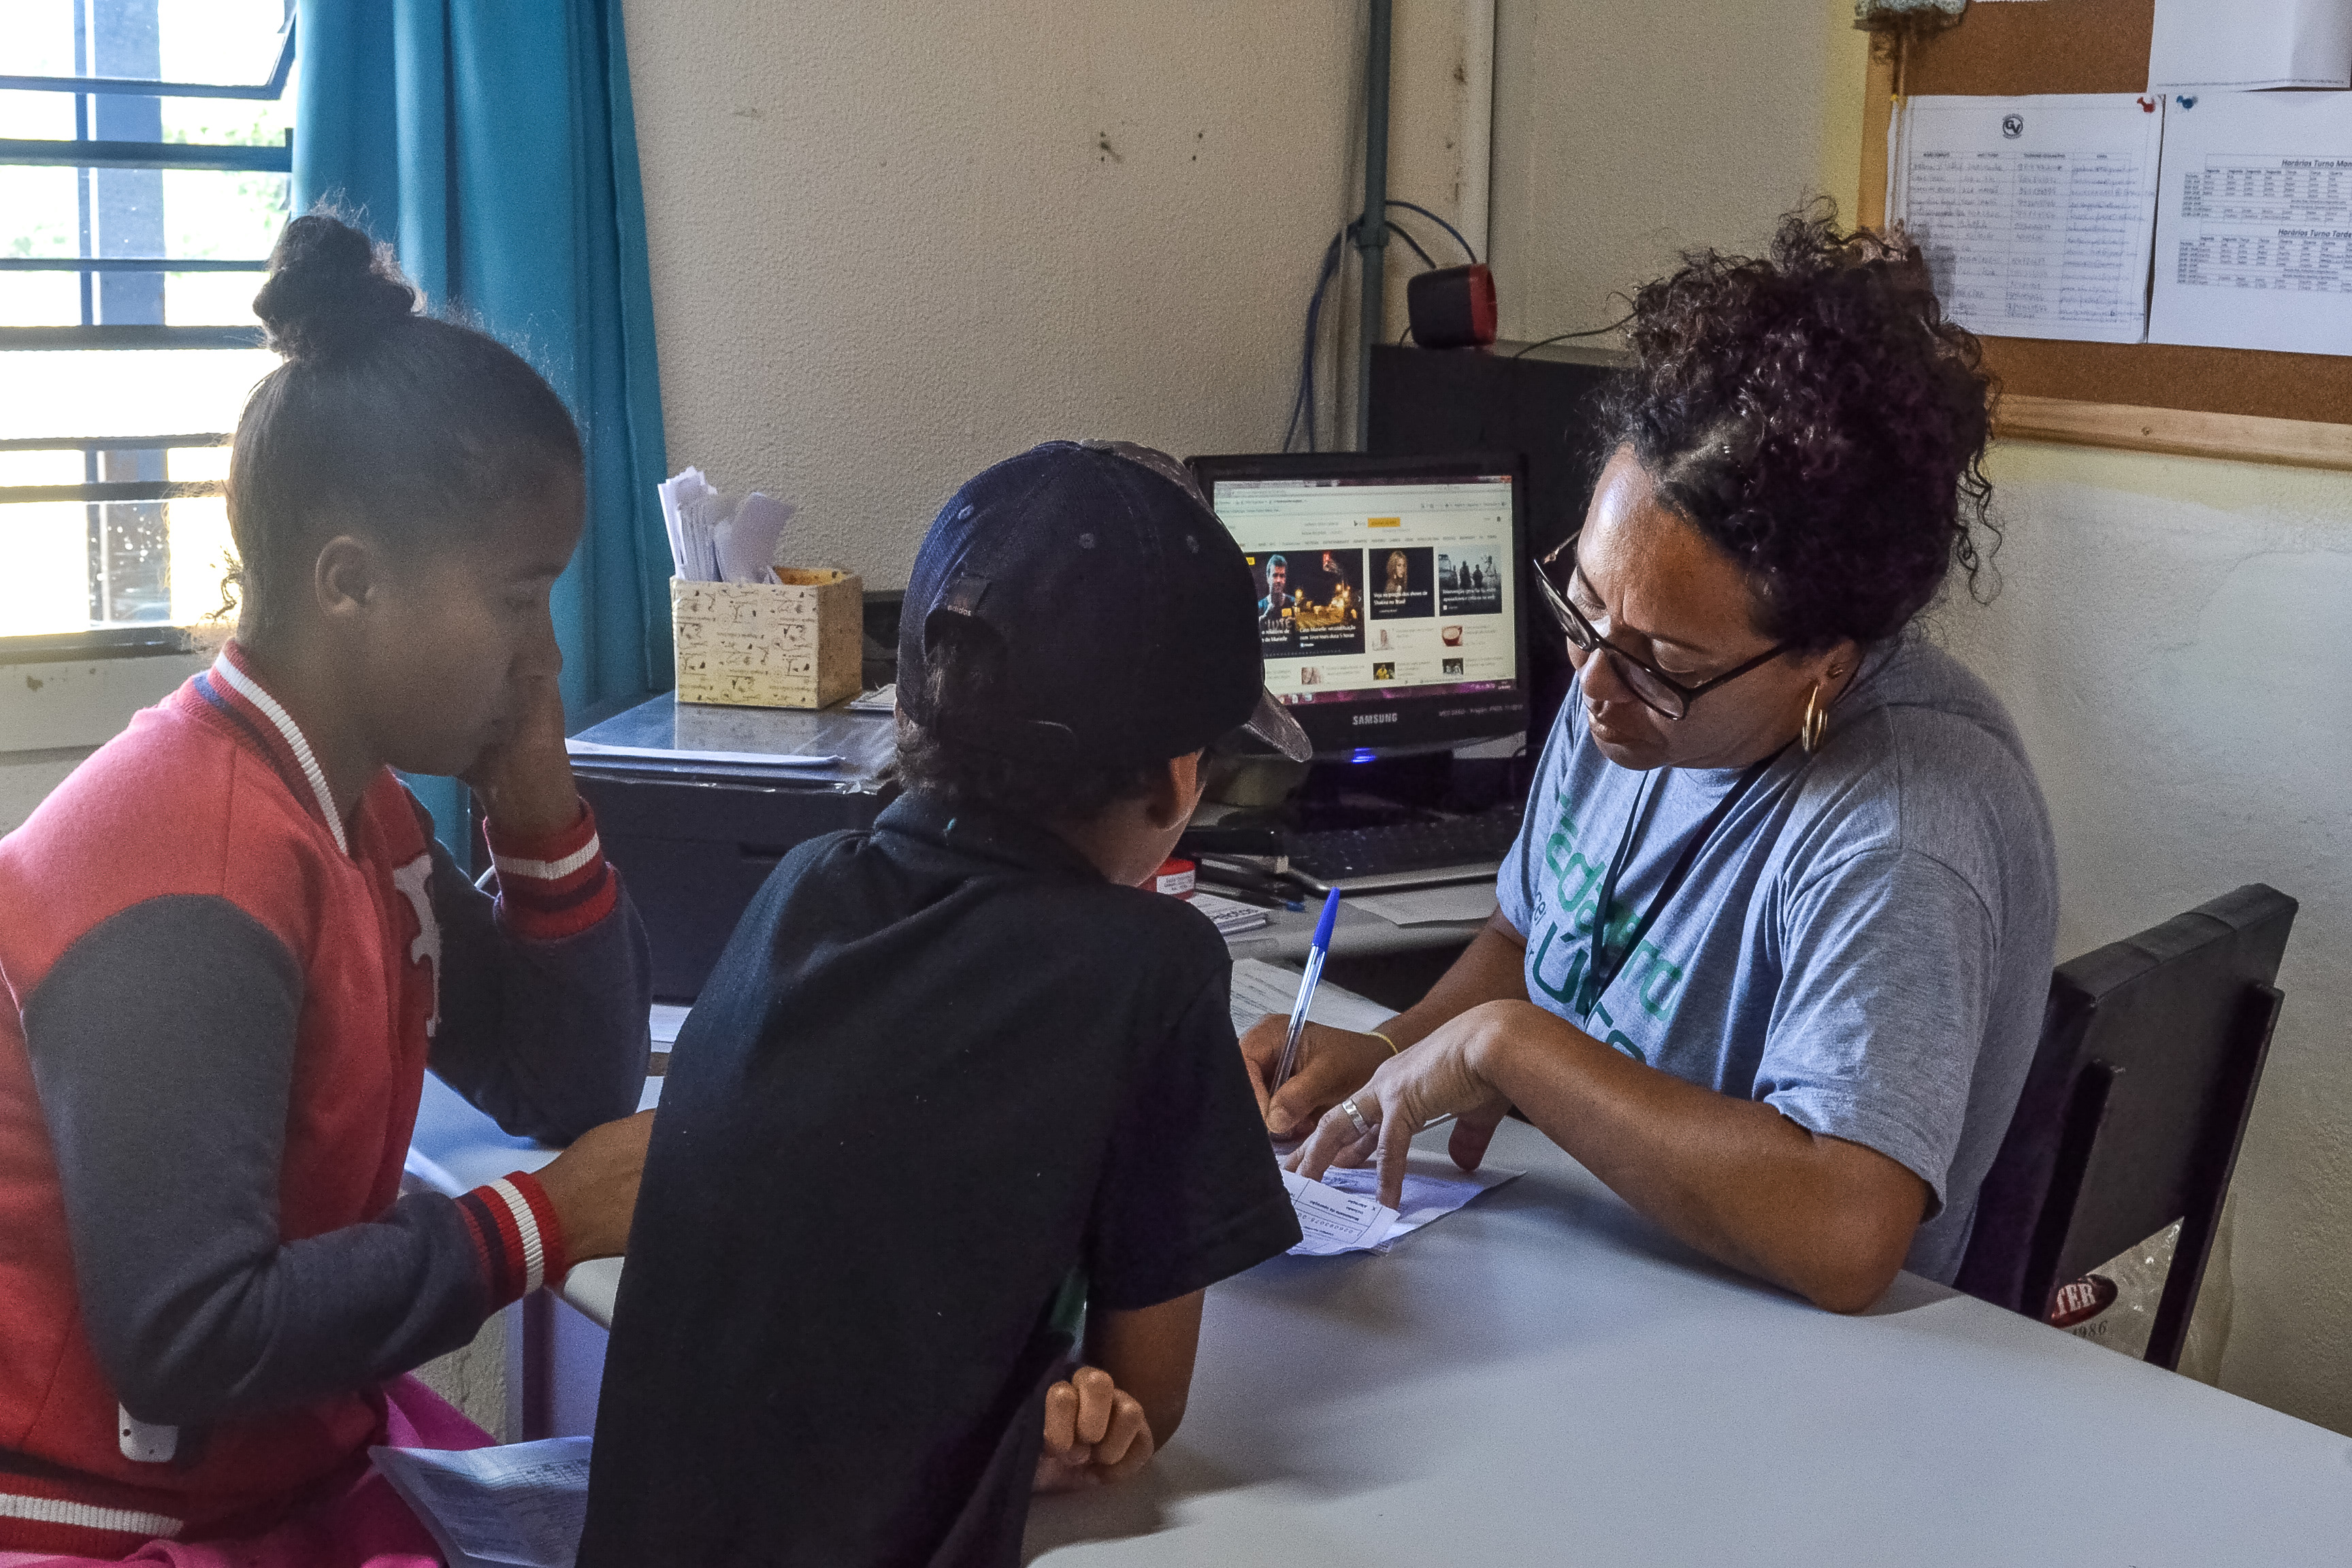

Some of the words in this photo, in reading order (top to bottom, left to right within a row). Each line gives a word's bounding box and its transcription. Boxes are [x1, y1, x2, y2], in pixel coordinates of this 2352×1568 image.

[2282, 159, 2312, 167] Horários
[2315, 159, 2334, 167] Turno
[2278, 228, 2308, 236] Horários
[2311, 229, 2330, 238] Turno
[947, 604, 972, 616] adidas
[1352, 713, 1398, 725] SAMSUNG
